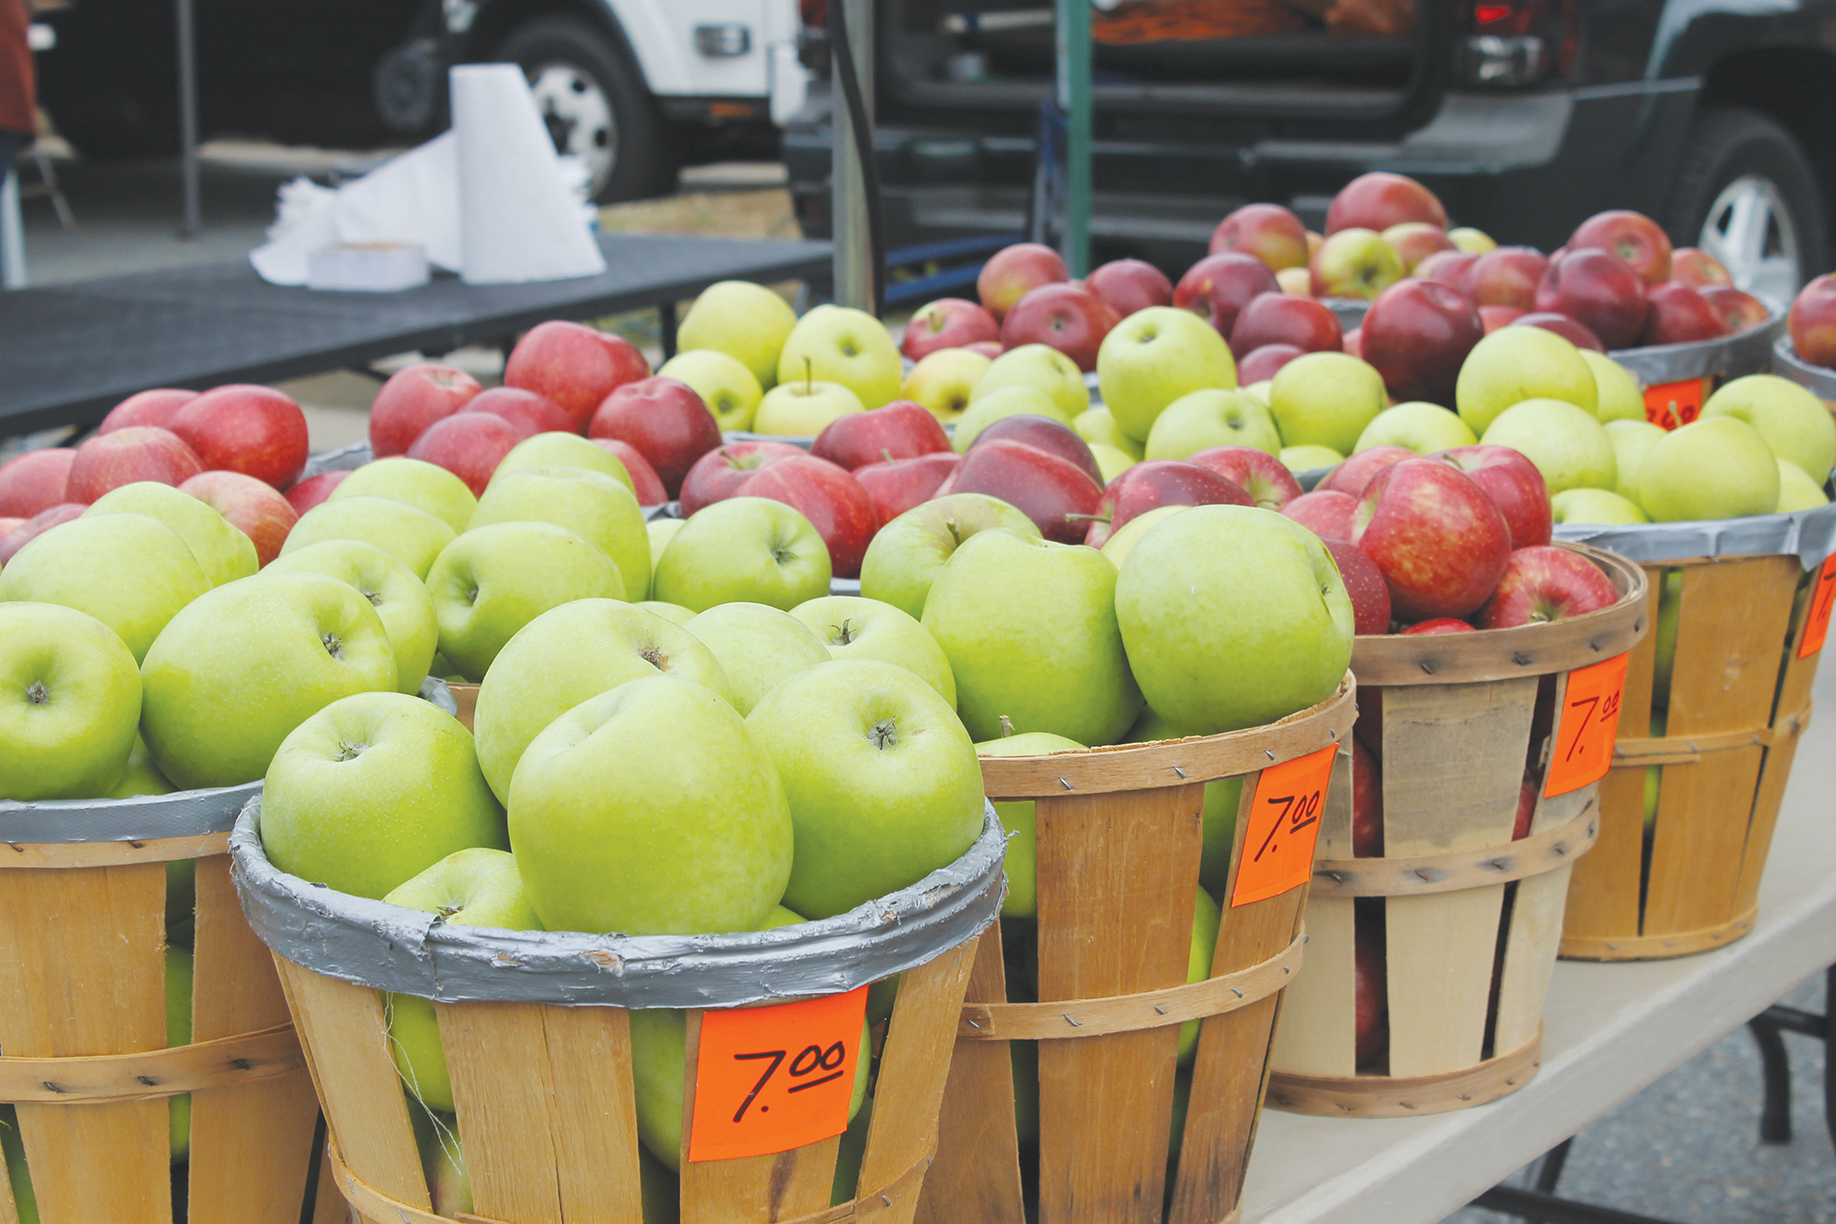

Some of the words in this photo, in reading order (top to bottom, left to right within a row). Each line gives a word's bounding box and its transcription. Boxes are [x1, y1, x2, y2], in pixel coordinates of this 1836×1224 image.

[1566, 690, 1620, 762] 7.00
[1254, 790, 1320, 862] 7.00
[733, 1041, 846, 1123] 7.00
